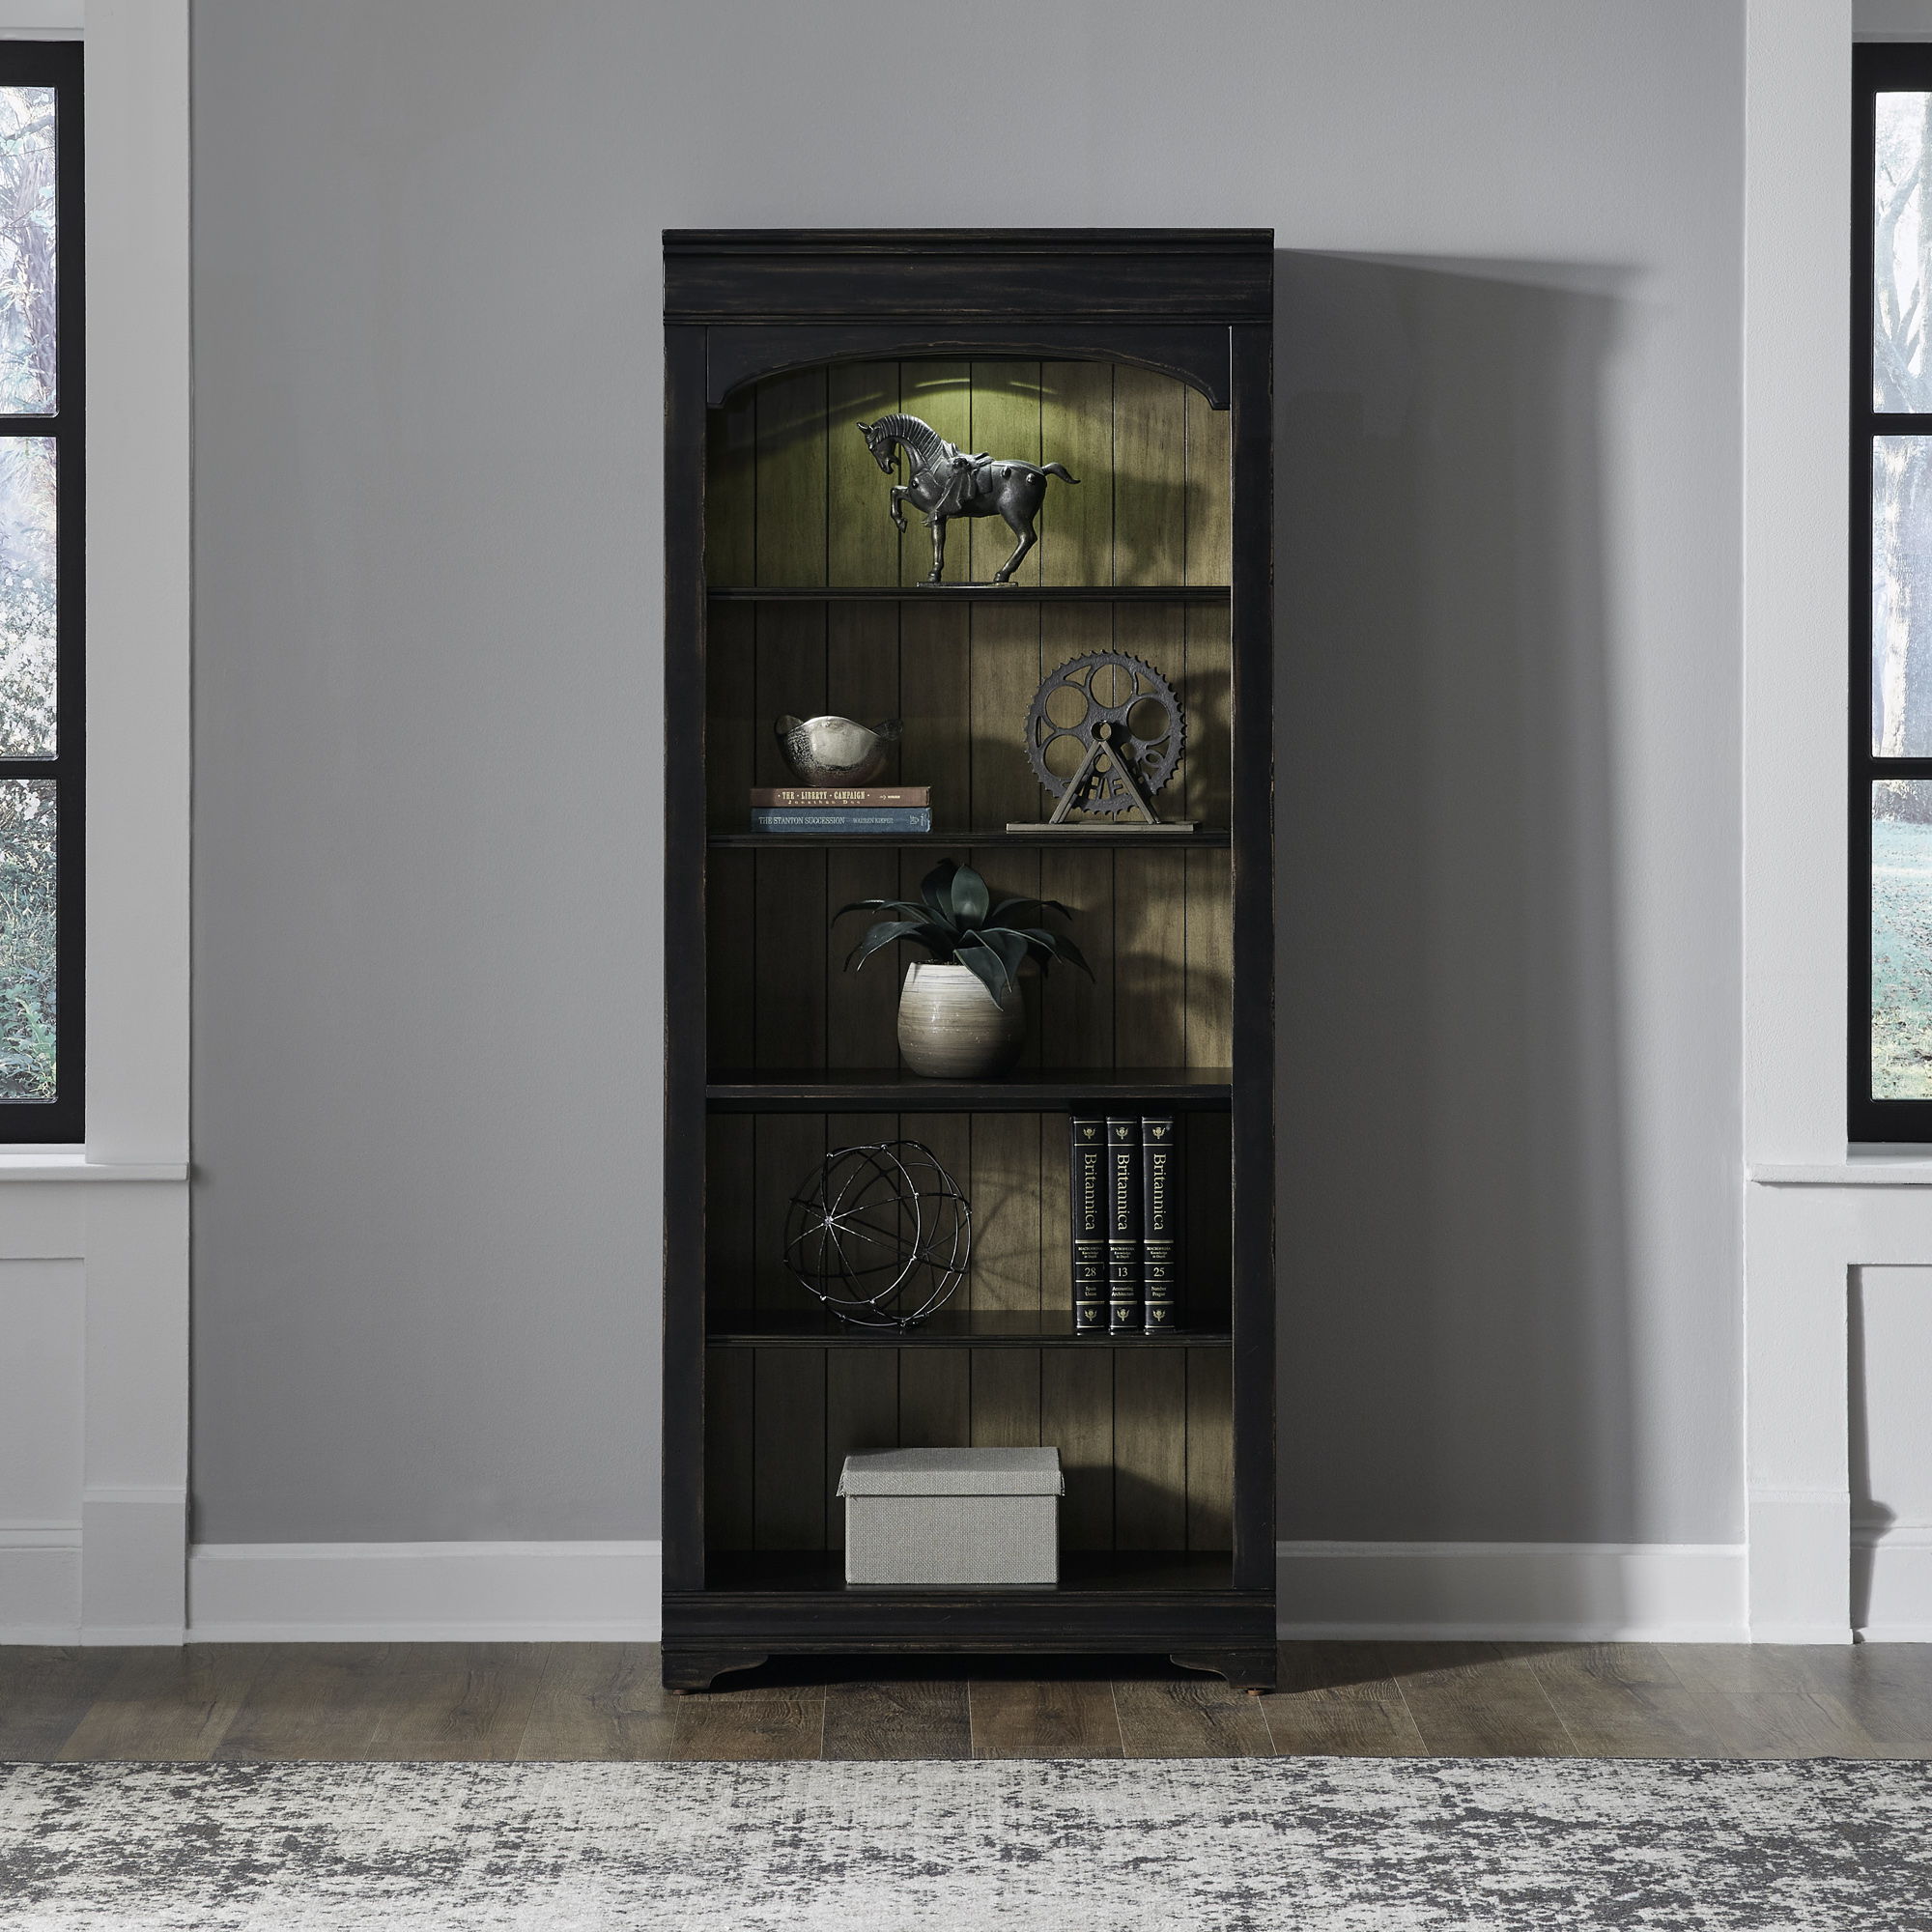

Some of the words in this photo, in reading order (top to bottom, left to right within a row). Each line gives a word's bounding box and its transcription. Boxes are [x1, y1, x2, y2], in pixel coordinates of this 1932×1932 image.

[781, 791, 795, 800] THE
[801, 791, 828, 800] LIBERTY
[834, 790, 866, 800] CAMPAIGN
[758, 816, 773, 825] THE
[773, 816, 804, 825] STANTON
[805, 816, 845, 825] SUCCESSION
[1084, 1152, 1097, 1231] Britannica
[1117, 1153, 1130, 1231] Britannica
[1153, 1153, 1167, 1231] Britannica
[1084, 1266, 1097, 1277] 28
[1118, 1266, 1128, 1277] 13
[1153, 1266, 1165, 1277] 25
